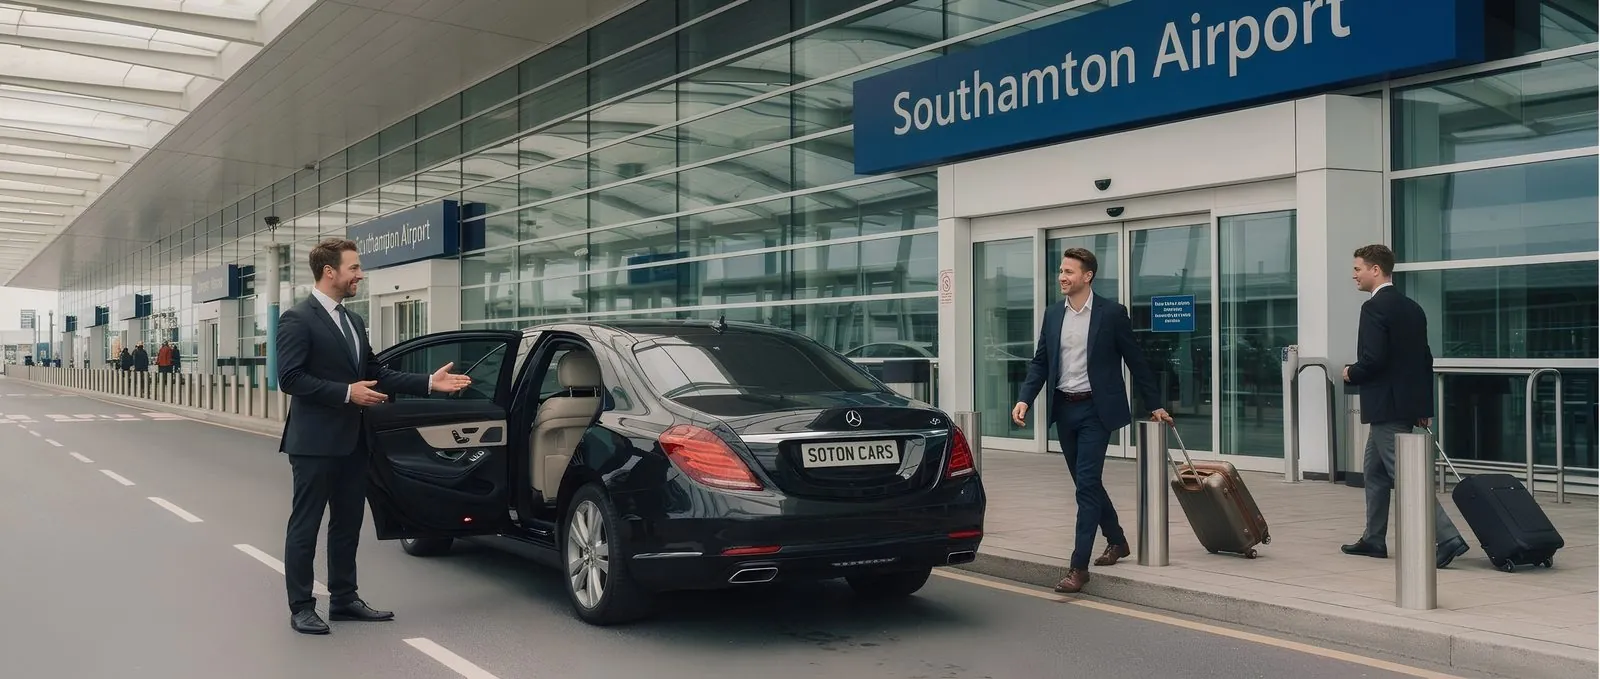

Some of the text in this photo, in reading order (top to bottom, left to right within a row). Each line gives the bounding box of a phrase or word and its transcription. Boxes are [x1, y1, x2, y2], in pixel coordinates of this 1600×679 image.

[893, 0, 1351, 136] Southamton Airport
[401, 219, 430, 249] Airport
[808, 445, 893, 463] SOTON CARS
